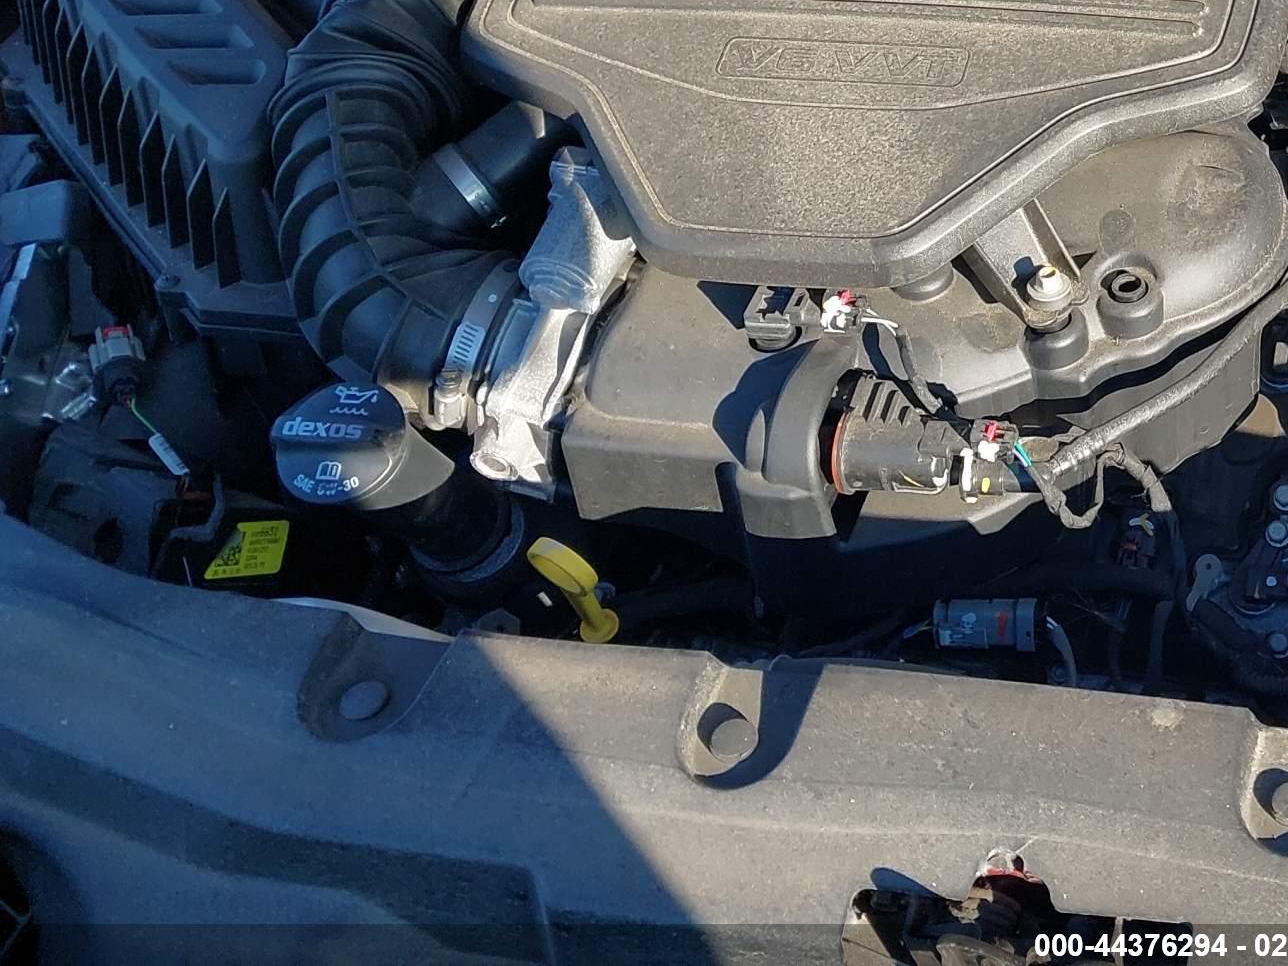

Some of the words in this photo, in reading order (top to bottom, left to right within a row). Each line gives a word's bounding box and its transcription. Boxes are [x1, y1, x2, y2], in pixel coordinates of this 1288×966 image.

[736, 45, 820, 73] V6
[835, 49, 964, 79] VVT
[281, 417, 367, 439] dexos
[294, 474, 316, 493] SAE
